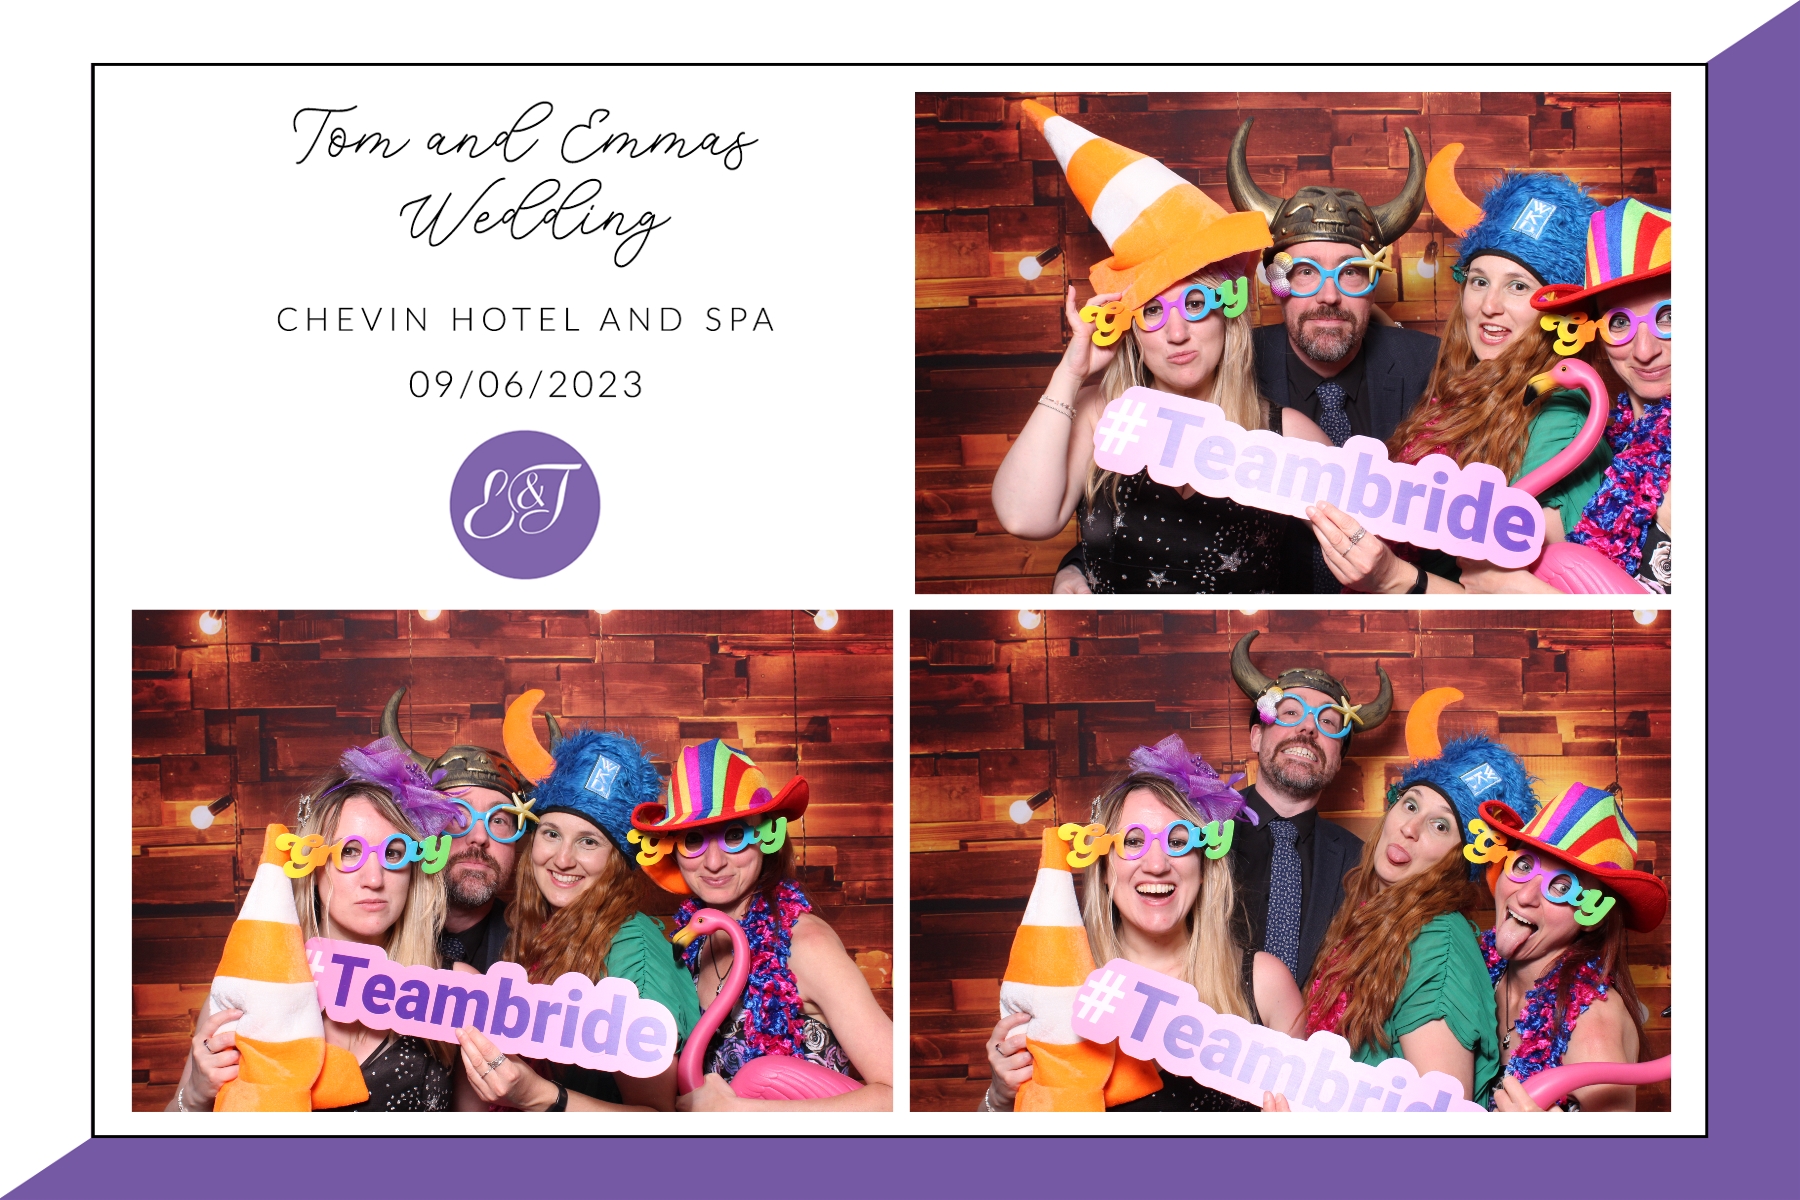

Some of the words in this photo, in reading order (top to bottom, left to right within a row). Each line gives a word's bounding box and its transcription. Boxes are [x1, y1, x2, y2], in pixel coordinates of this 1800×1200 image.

[1519, 200, 1552, 233] WKD
[1098, 399, 1536, 553] #Teambride
[591, 757, 618, 791] WKD
